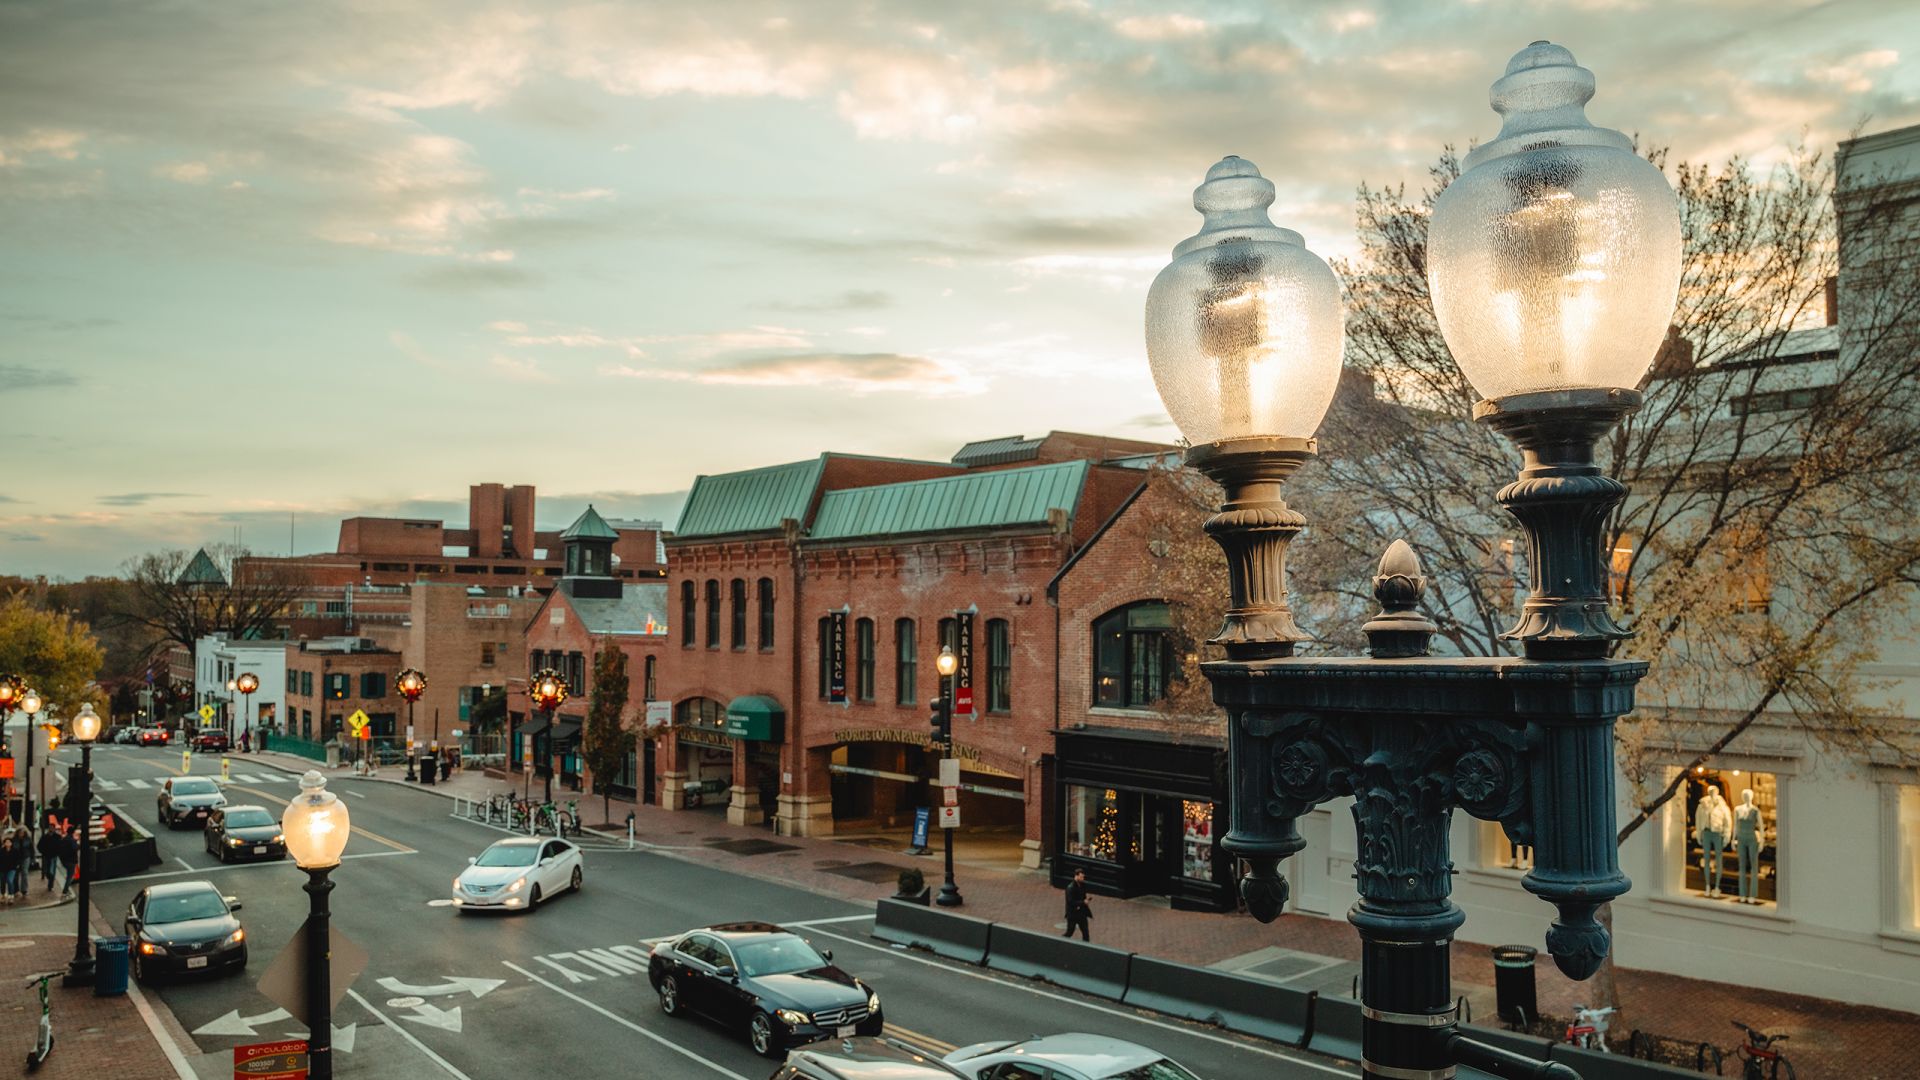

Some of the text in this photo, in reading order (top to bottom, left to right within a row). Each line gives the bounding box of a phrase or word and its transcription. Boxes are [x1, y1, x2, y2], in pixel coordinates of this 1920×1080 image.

[834, 614, 842, 680] PARKING
[961, 614, 969, 688] PARKING
[833, 727, 900, 741] GEORGETOWN
